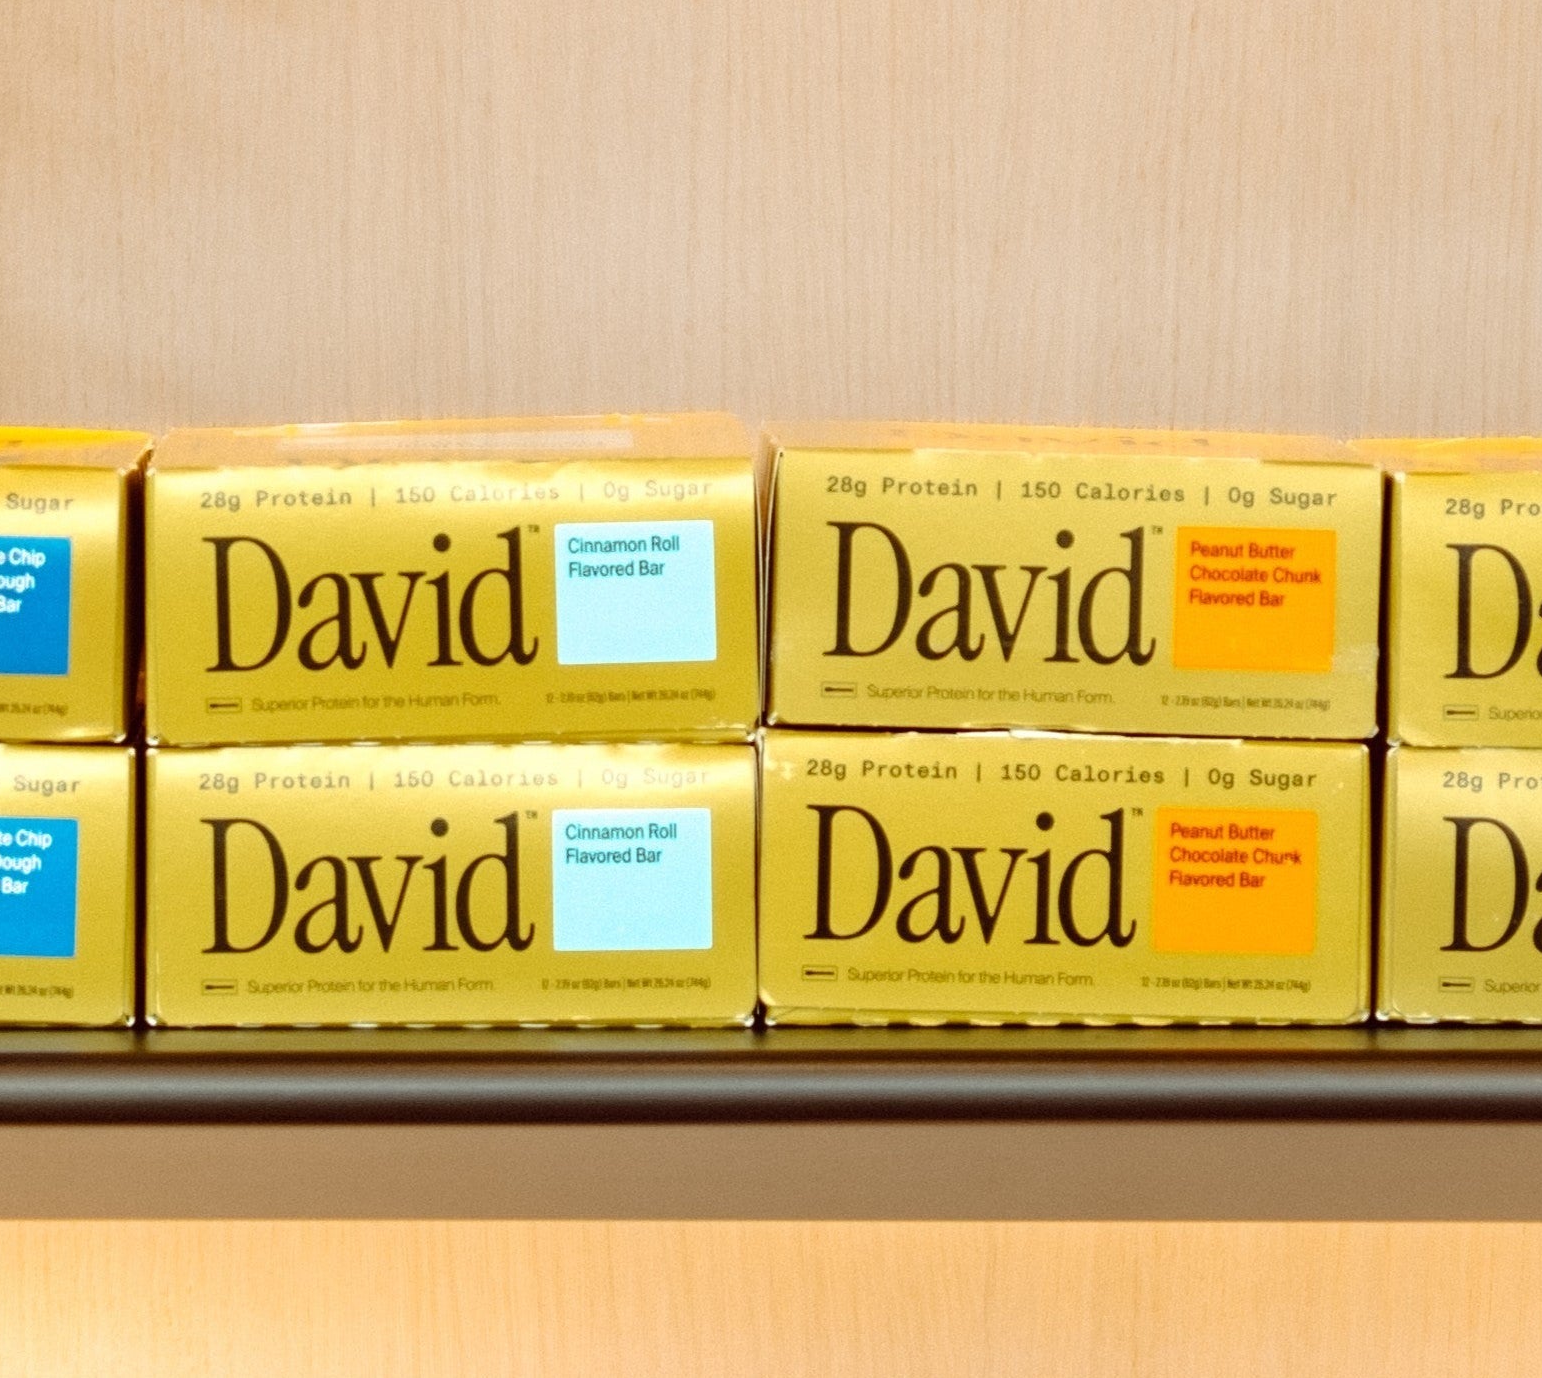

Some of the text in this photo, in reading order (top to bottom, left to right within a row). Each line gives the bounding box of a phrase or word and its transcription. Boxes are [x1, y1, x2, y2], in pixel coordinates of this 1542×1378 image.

[199, 478, 711, 513] 28g Protein 150 Calories 0g Sugar
[826, 475, 1337, 511] 28g Protein 150 Calories 0g Sugar
[5, 492, 74, 516] Sugar
[1444, 497, 1485, 520] 28g
[567, 534, 680, 554] Cinnamon Roll
[1189, 540, 1295, 560] Peanut Butter
[8, 547, 46, 568] Chip
[568, 558, 665, 578] Flavored Bar
[1189, 564, 1321, 584] Chocolate Chunk
[1188, 587, 1285, 607] Flavored Bar
[250, 695, 308, 714] Superior
[311, 694, 360, 710] Protein
[361, 694, 380, 709] for
[382, 694, 405, 708] the
[407, 692, 459, 708] Human
[865, 683, 924, 700] Superior
[926, 685, 975, 700] Protein
[976, 687, 995, 701] for
[997, 688, 1020, 702] the
[1022, 688, 1074, 703] Human
[198, 766, 709, 795] 28g Protein 150 Calories 0g Sugar
[806, 758, 1316, 791] 28g Protein 150 Calories 0g Sugar
[1442, 770, 1483, 793] 28g
[13, 774, 81, 798] Sugar
[15, 829, 53, 850] Chip
[564, 822, 677, 841] Cinnamon Roll
[1169, 821, 1275, 841] Peanut Butter
[565, 846, 662, 864] Flavored Bar
[1169, 845, 1249, 864] Chocolate
[1, 876, 29, 894] Bar
[1168, 869, 1265, 888] Flavored Bar
[846, 966, 904, 983] Superior
[907, 968, 955, 983] Protein
[957, 969, 975, 984] for
[978, 970, 1001, 984] the
[1003, 971, 1054, 985] Human
[246, 978, 304, 996] Superior
[307, 977, 355, 993] Protein
[357, 978, 375, 992] for
[378, 978, 401, 992] the
[403, 977, 454, 992] Human
[1483, 978, 1541, 995] Superior
